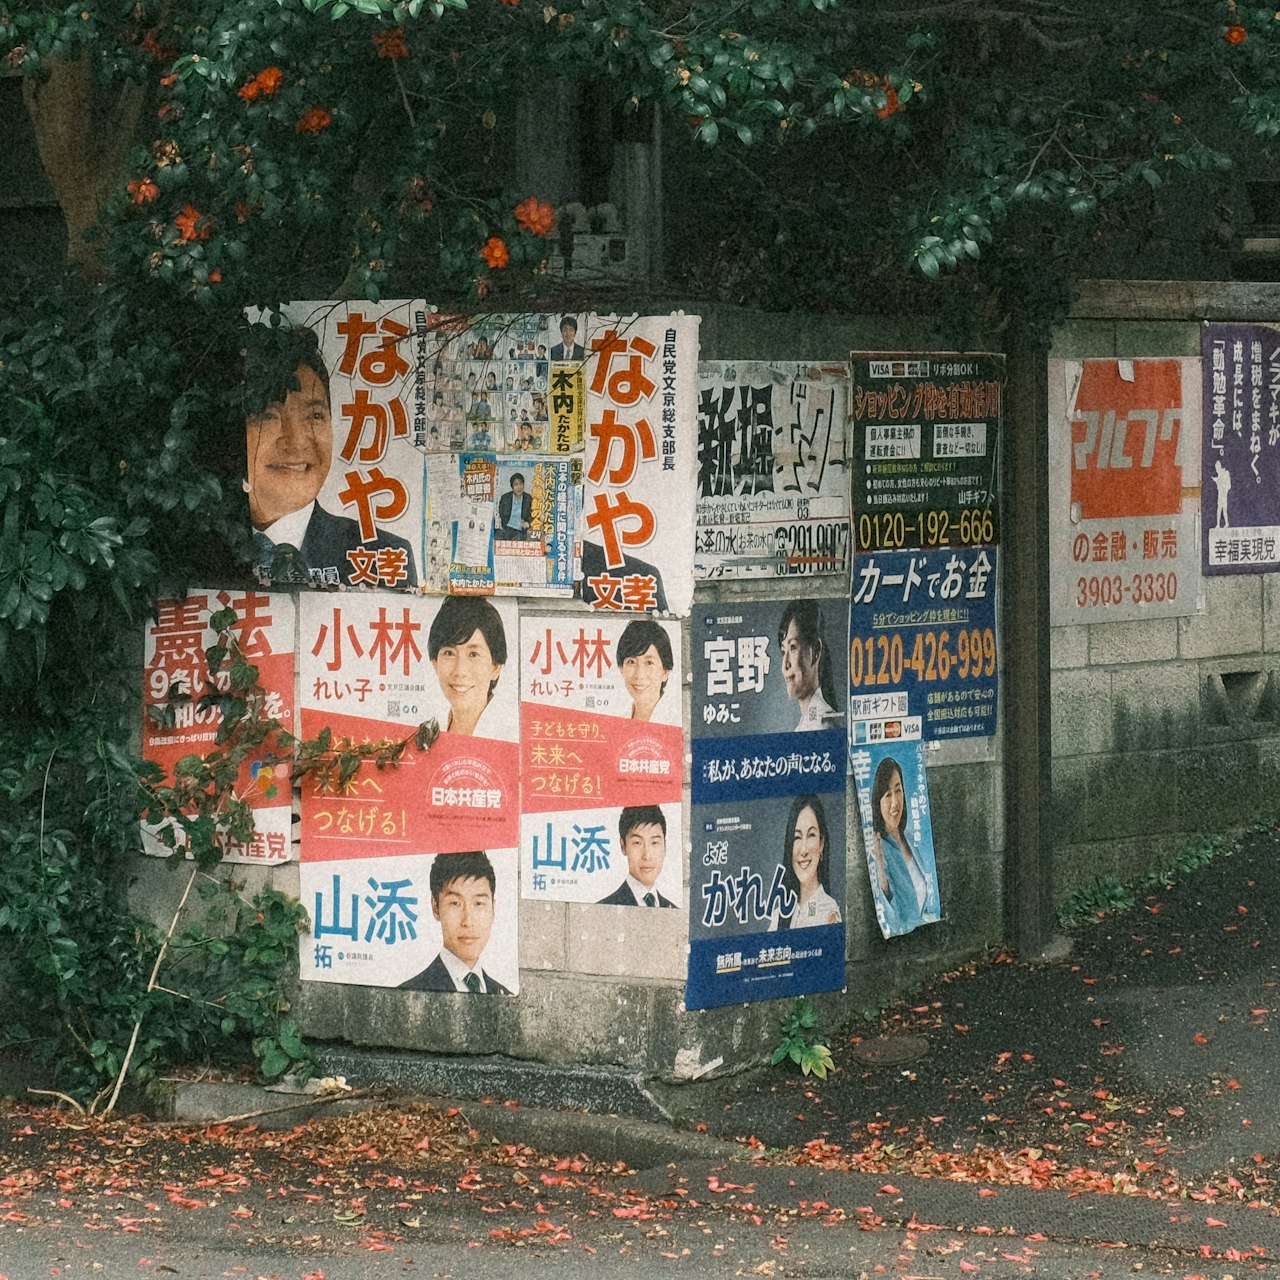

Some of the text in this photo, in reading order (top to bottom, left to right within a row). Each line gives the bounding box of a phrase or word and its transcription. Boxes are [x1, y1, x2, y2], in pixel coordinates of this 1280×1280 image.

[872, 364, 890, 375] VISA
[662, 328, 677, 471] 自民党文京総支部長
[1232, 340, 1244, 438] 成長には、
[336, 311, 412, 543] なかや
[1250, 341, 1263, 484] 増税をまねく。
[586, 329, 660, 570] なかや
[859, 509, 994, 549] 0120-192-666
[1073, 530, 1177, 563] の金融・販売
[347, 546, 409, 586] 文孝
[1214, 538, 1276, 562] 幸福実現党
[589, 573, 658, 612] 文孝
[853, 551, 992, 604] カードでお金
[1076, 571, 1178, 608] 3903-3330
[150, 591, 273, 668] 憲法
[311, 607, 423, 676] 小林
[529, 628, 613, 678] 小林
[704, 636, 771, 696] 宮野
[851, 627, 996, 688] 0120-426-999
[313, 677, 373, 703] れい子
[530, 679, 575, 698] れい子
[852, 697, 897, 716] 駅前ギフト
[531, 721, 606, 740] 子どもを守り、
[703, 703, 741, 725] ゆみこ
[903, 723, 920, 734] VISA
[531, 745, 583, 765] 未来へ
[619, 758, 671, 775] 日本共産党
[708, 752, 837, 784] 私が、あなたの声になる。
[432, 787, 502, 809] 日本共産党
[532, 822, 611, 874] 山添
[703, 841, 729, 866] よだ
[532, 872, 547, 891] 拓
[702, 863, 798, 927] かれん
[314, 874, 418, 945] 山添
[314, 943, 333, 969] 拓
